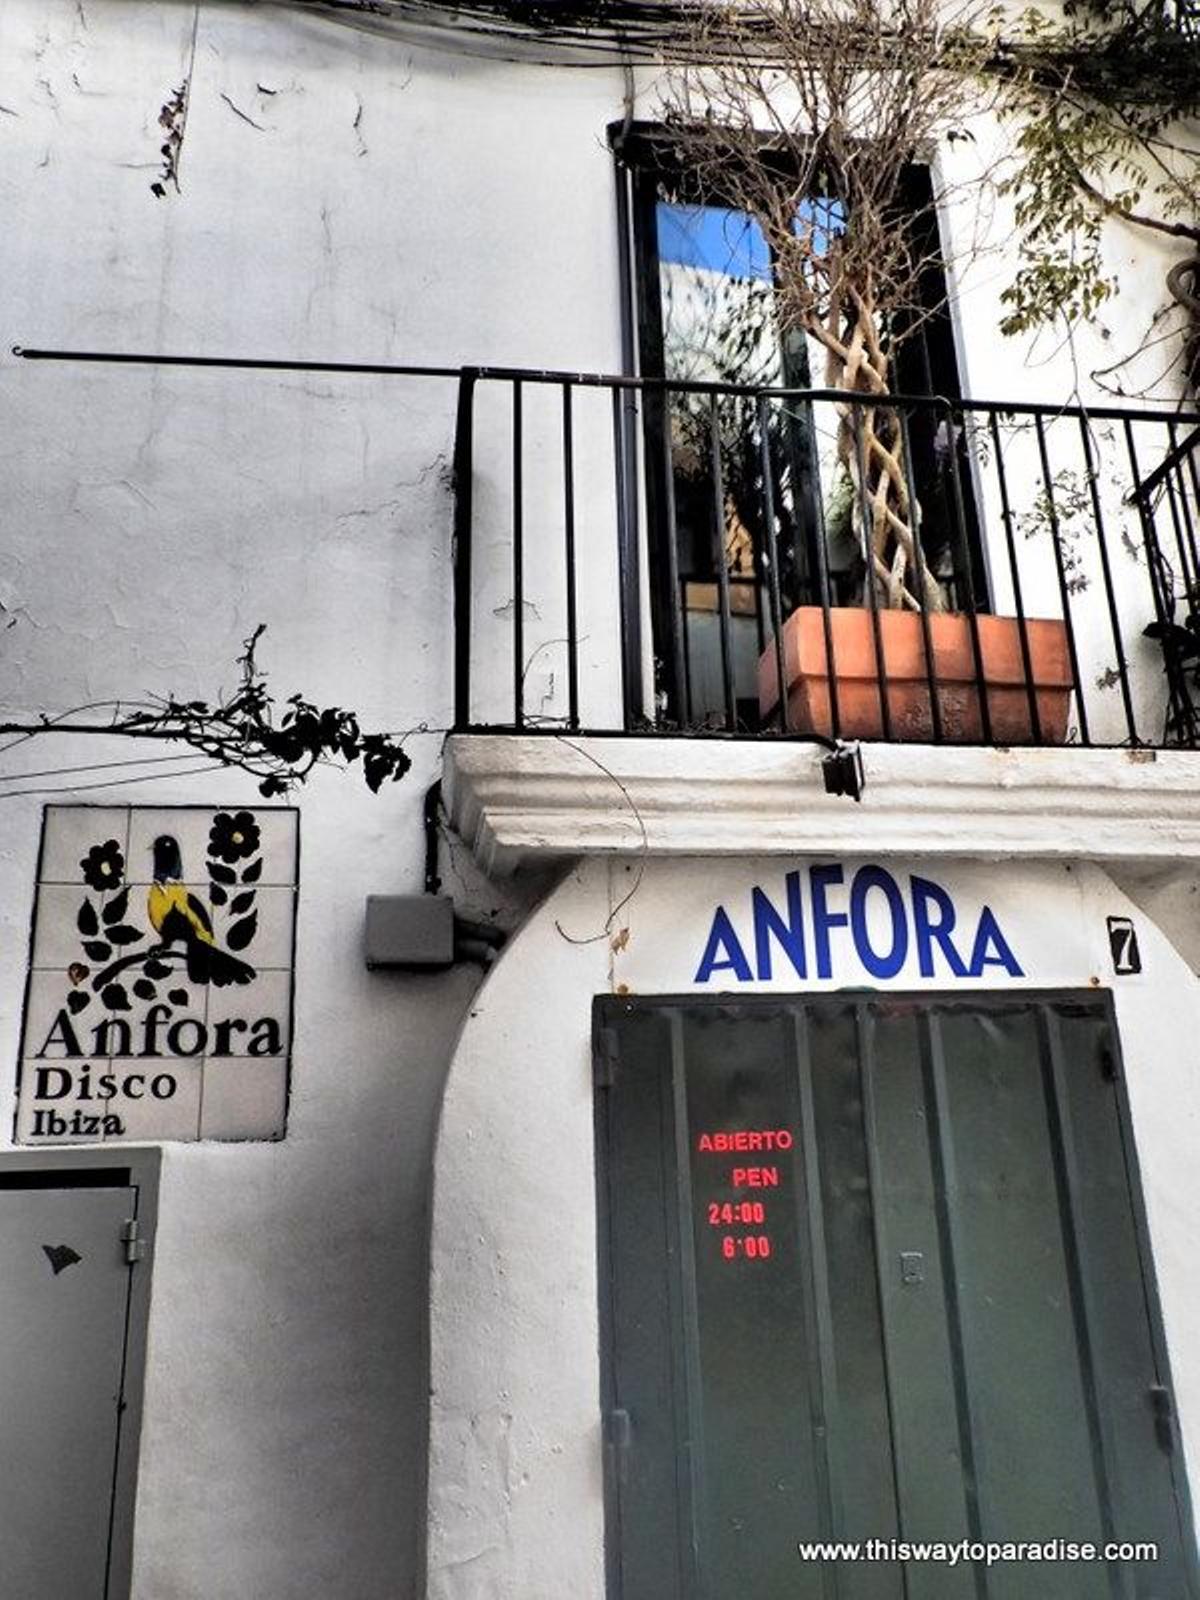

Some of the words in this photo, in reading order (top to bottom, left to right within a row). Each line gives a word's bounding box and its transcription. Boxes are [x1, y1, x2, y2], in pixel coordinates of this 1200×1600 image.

[694, 863, 1025, 982] ANFORA
[1109, 919, 1137, 972] 7
[34, 1004, 284, 1058] Anfora
[34, 1064, 177, 1100] Disco
[30, 1109, 126, 1136] Ibiza
[699, 1130, 792, 1151] ABIERTO
[732, 1167, 779, 1187] PEN
[708, 1202, 764, 1225] 24:00
